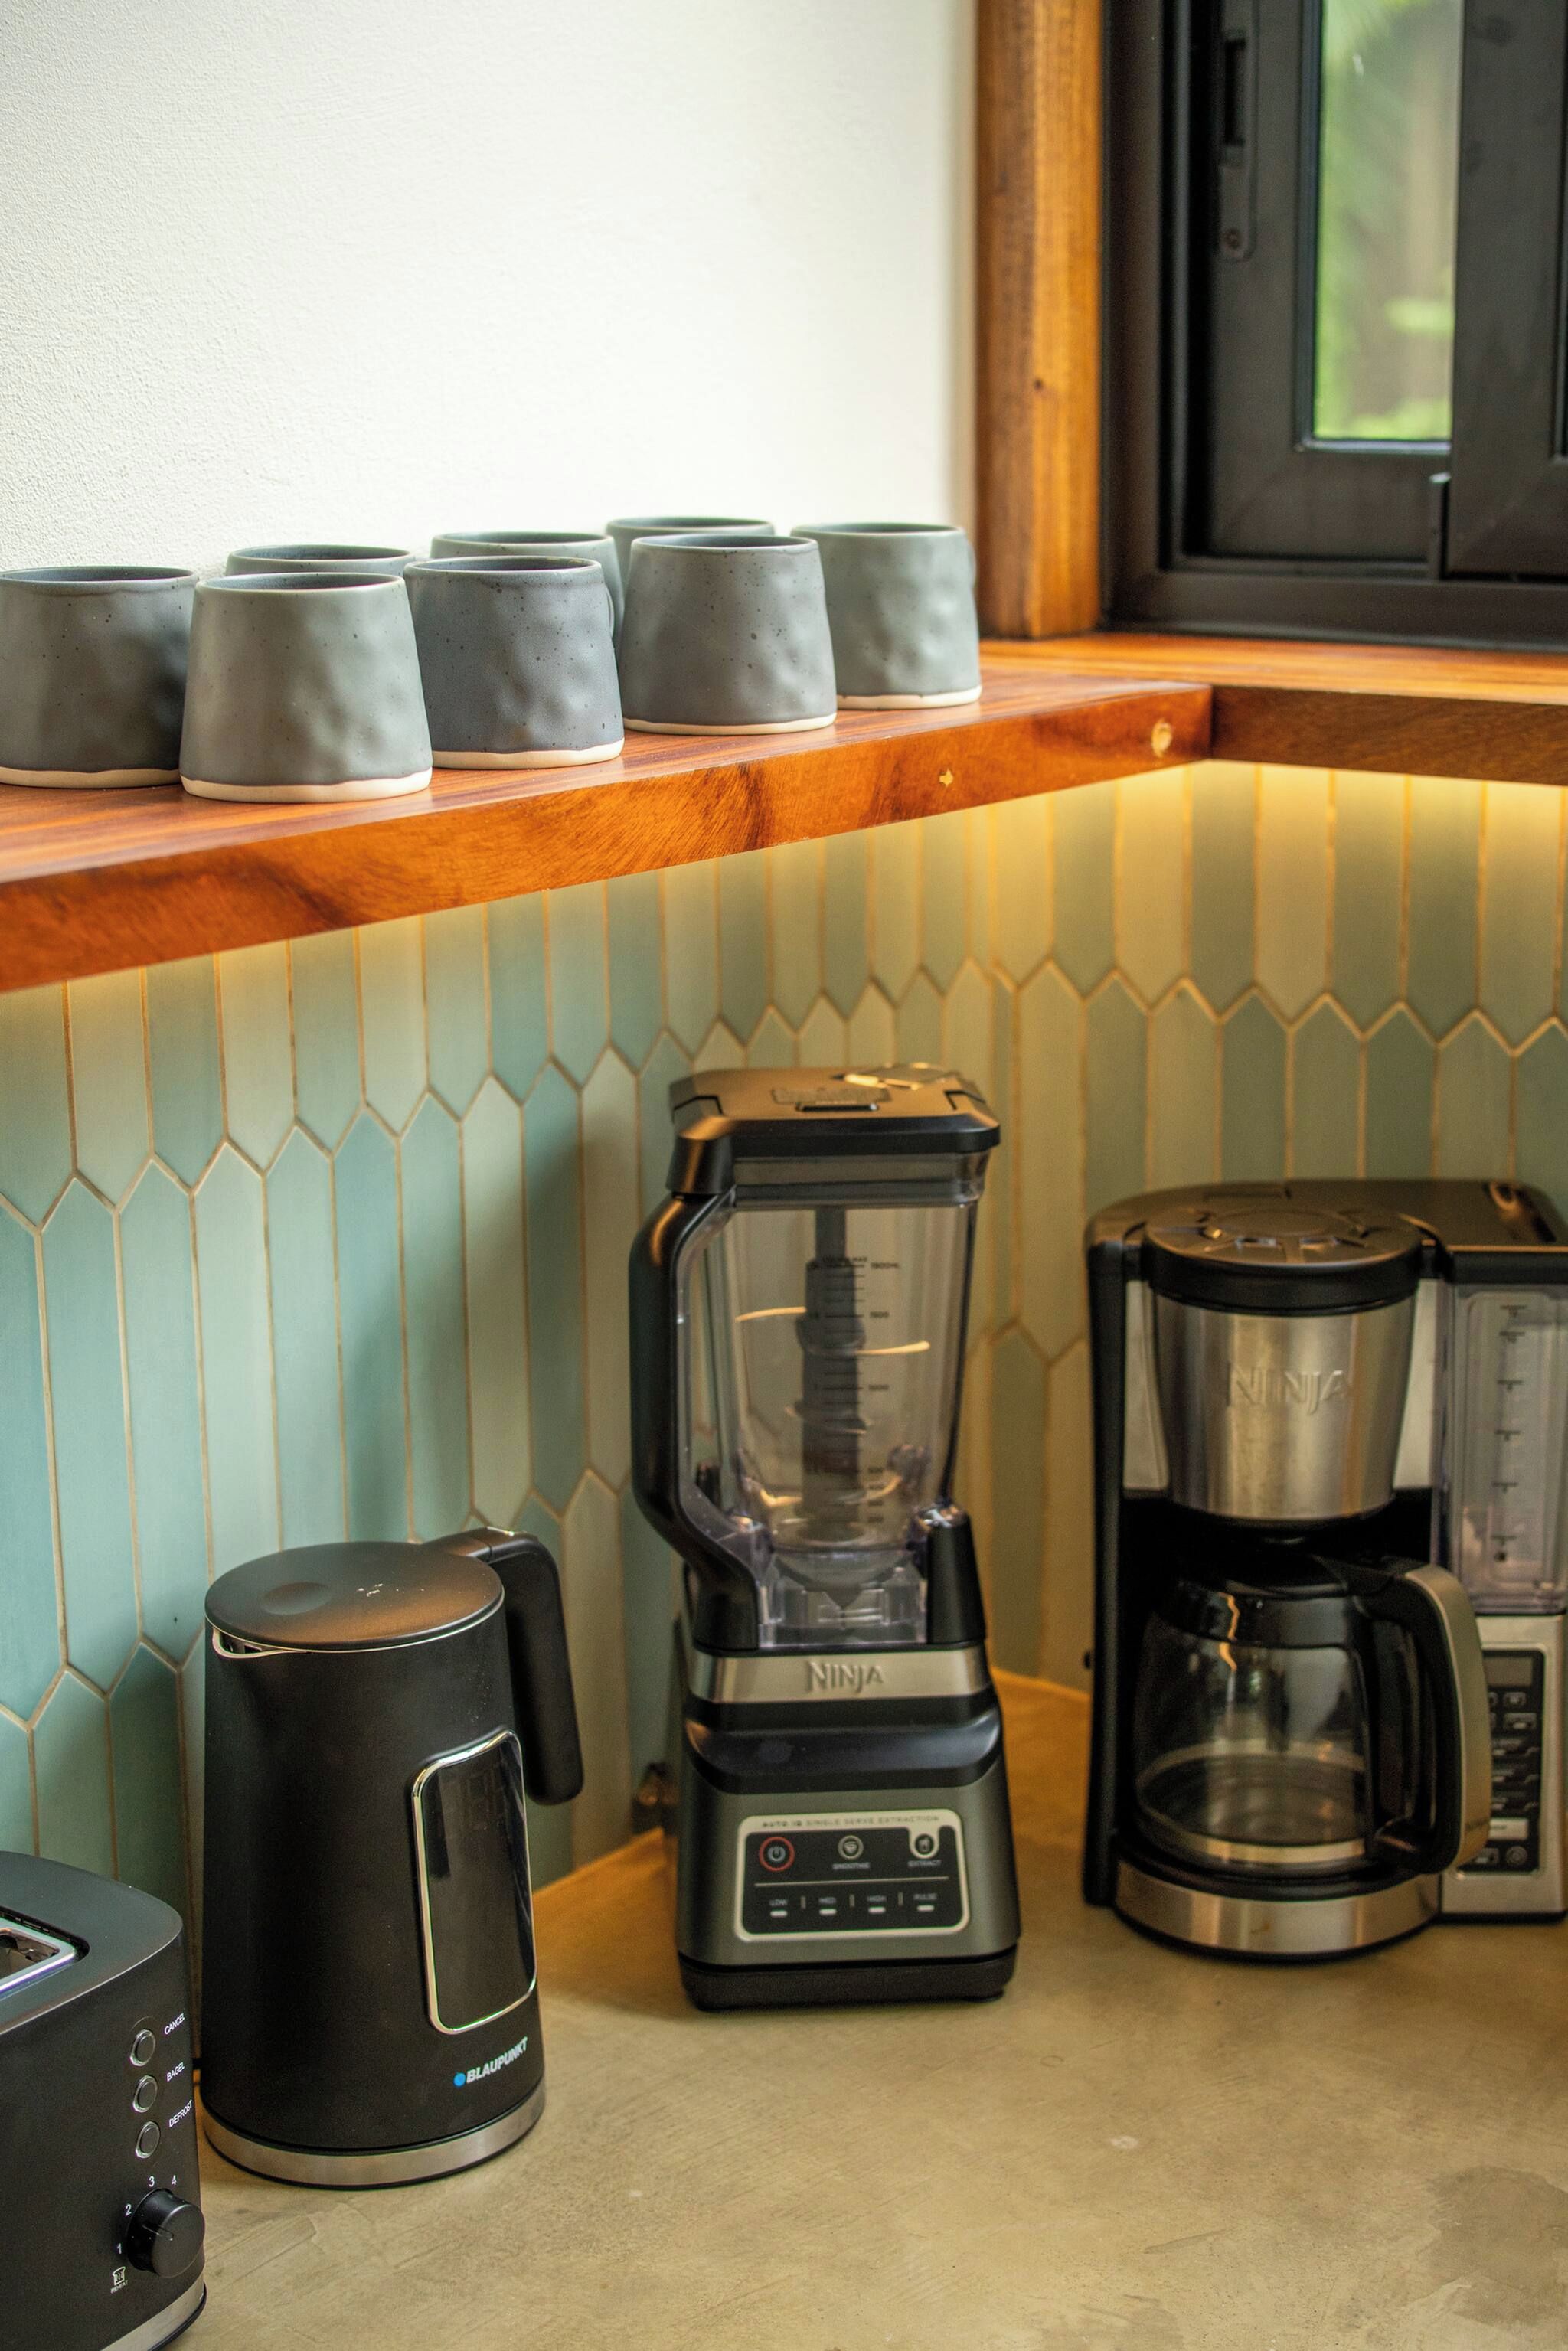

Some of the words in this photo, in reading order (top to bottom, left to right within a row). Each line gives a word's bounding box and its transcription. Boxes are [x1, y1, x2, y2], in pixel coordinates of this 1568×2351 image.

[1226, 1360, 1346, 1416] NINJA
[805, 1660, 884, 1693] NINJA
[769, 1898, 788, 1907] LOW
[818, 1895, 837, 1905] MED
[164, 2013, 185, 2035] CANCEL
[466, 2036, 528, 2083] BLAUPUNKT
[166, 2062, 185, 2082] BAGEL
[168, 2099, 192, 2127] DEFROST
[148, 2176, 155, 2187] 3
[171, 2174, 177, 2186] 4
[125, 2203, 132, 2216] 2
[116, 2242, 122, 2255] 1
[110, 2279, 129, 2294] REHEAT
